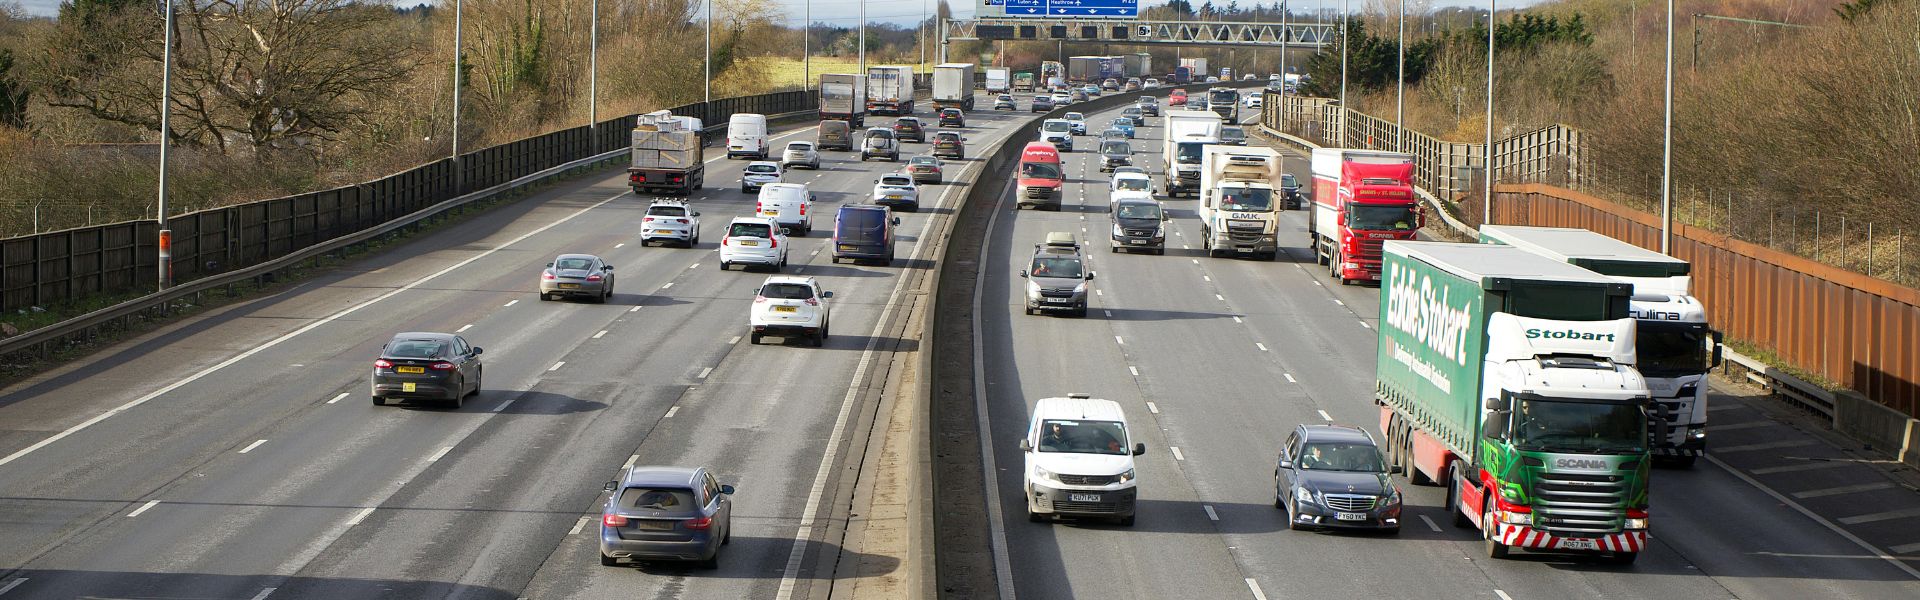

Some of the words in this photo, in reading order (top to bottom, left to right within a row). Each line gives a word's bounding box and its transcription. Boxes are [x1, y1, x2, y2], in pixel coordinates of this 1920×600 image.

[1387, 262, 1419, 338] Eddie
[1417, 274, 1471, 367] Stobart
[1525, 328, 1616, 343] Stobart
[1556, 458, 1608, 470] SCANIA
